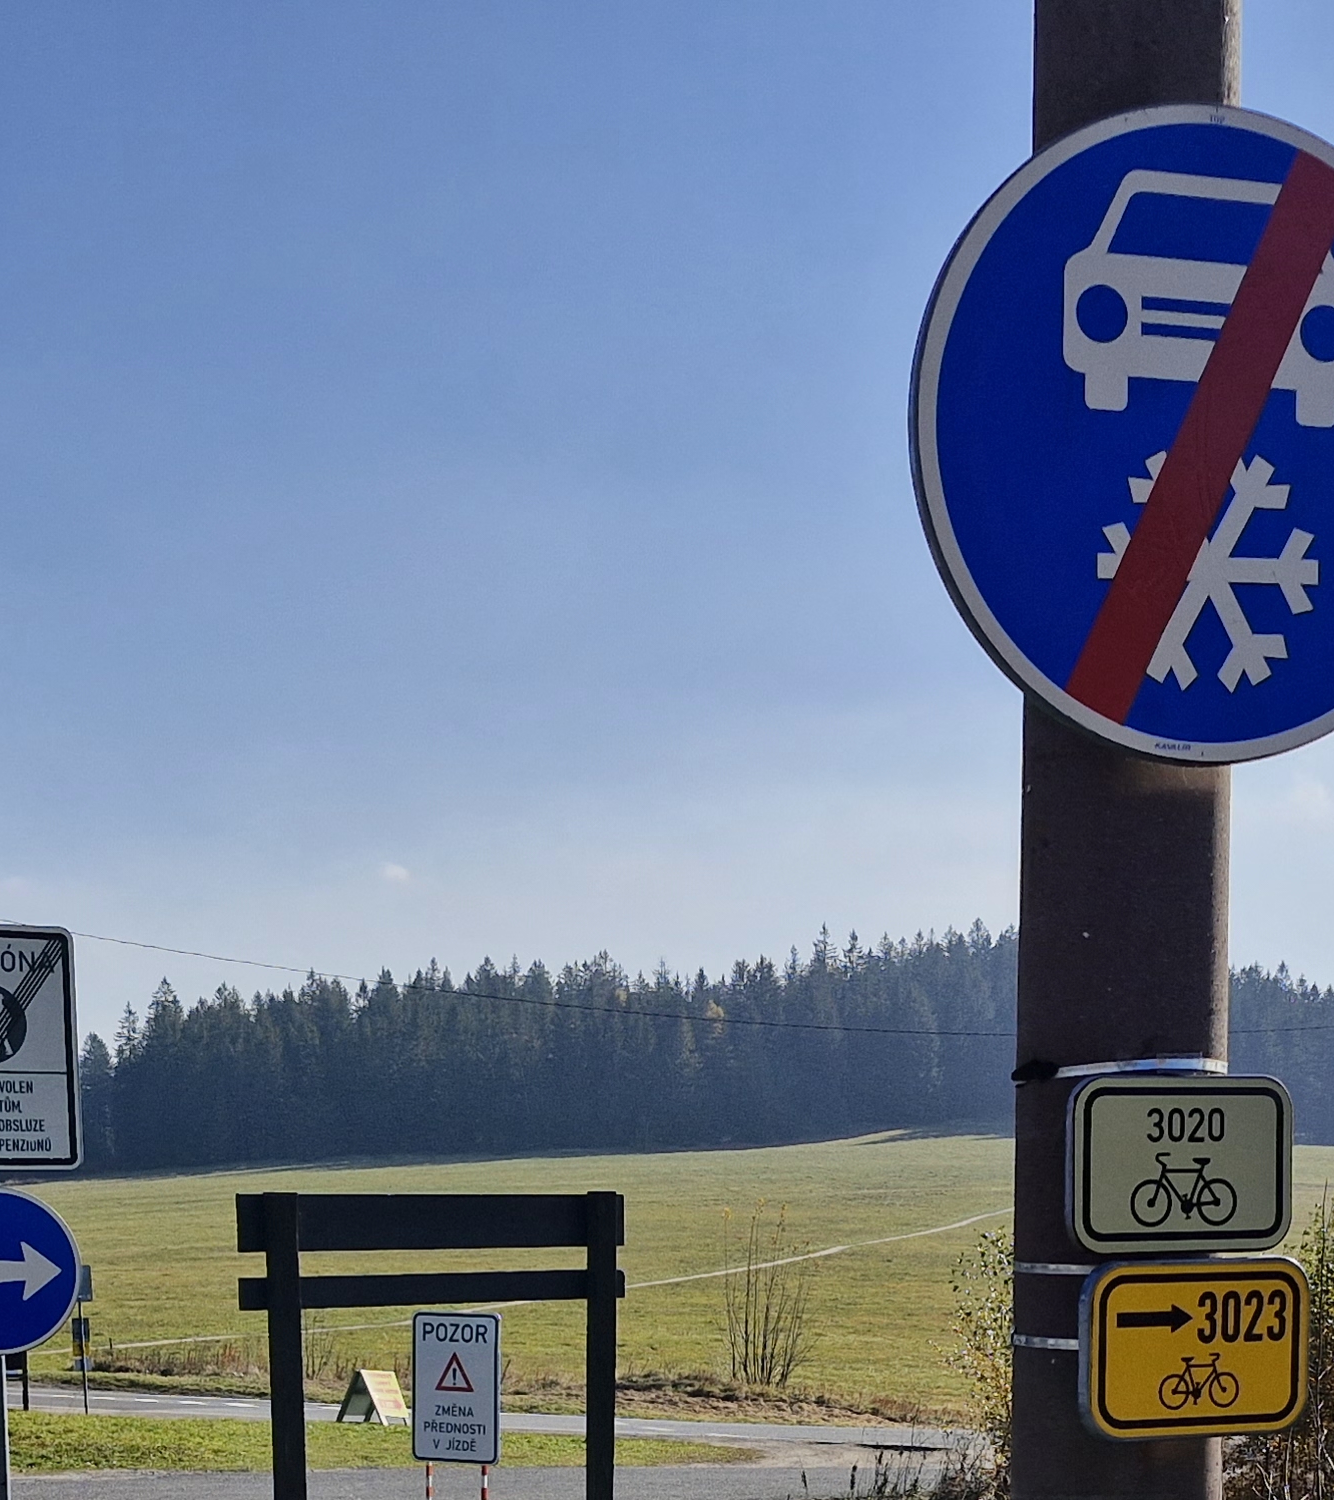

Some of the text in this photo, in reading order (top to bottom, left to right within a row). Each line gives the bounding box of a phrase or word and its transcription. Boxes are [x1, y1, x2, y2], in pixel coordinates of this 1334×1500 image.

[1146, 1107, 1225, 1143] 3020
[1196, 1289, 1287, 1344] 3023
[422, 1322, 488, 1343] POZOR
[434, 1403, 474, 1418] ZMĚNA
[423, 1419, 486, 1435] PŘEDNOSTI
[432, 1437, 477, 1452] V JÍZDĚ
